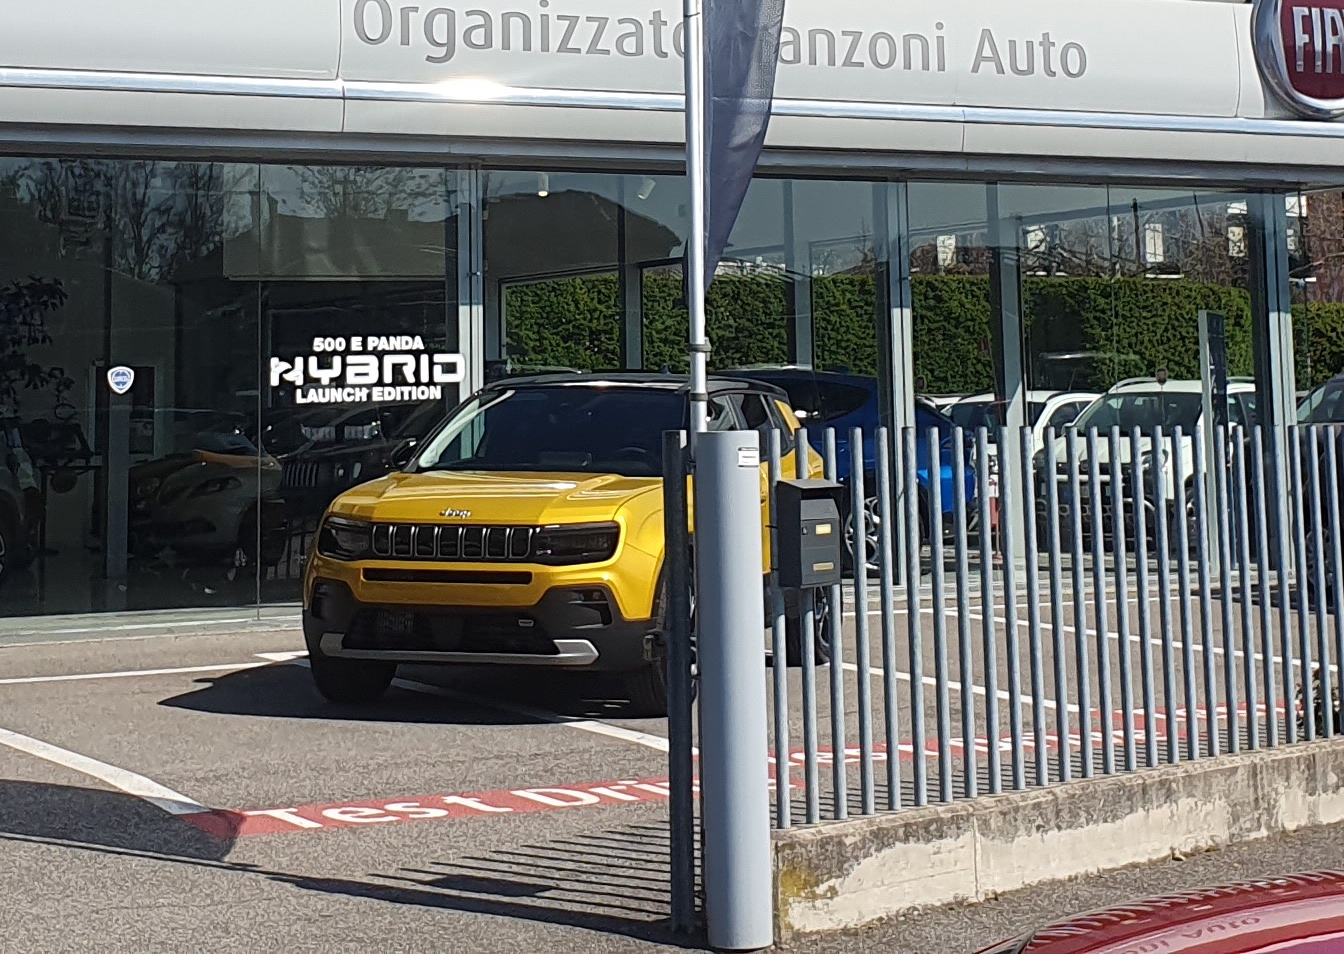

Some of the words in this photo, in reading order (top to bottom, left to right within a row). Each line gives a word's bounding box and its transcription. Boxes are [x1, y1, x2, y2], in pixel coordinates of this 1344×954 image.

[777, 22, 945, 72] anzoni
[970, 28, 1087, 78] Auto
[313, 337, 346, 352] 500
[350, 336, 363, 351] E
[367, 335, 425, 351] PANDA
[269, 353, 466, 387] HYBRID
[296, 387, 371, 404] LAUNCH
[371, 385, 442, 402] EDITION
[243, 794, 513, 829] Test
